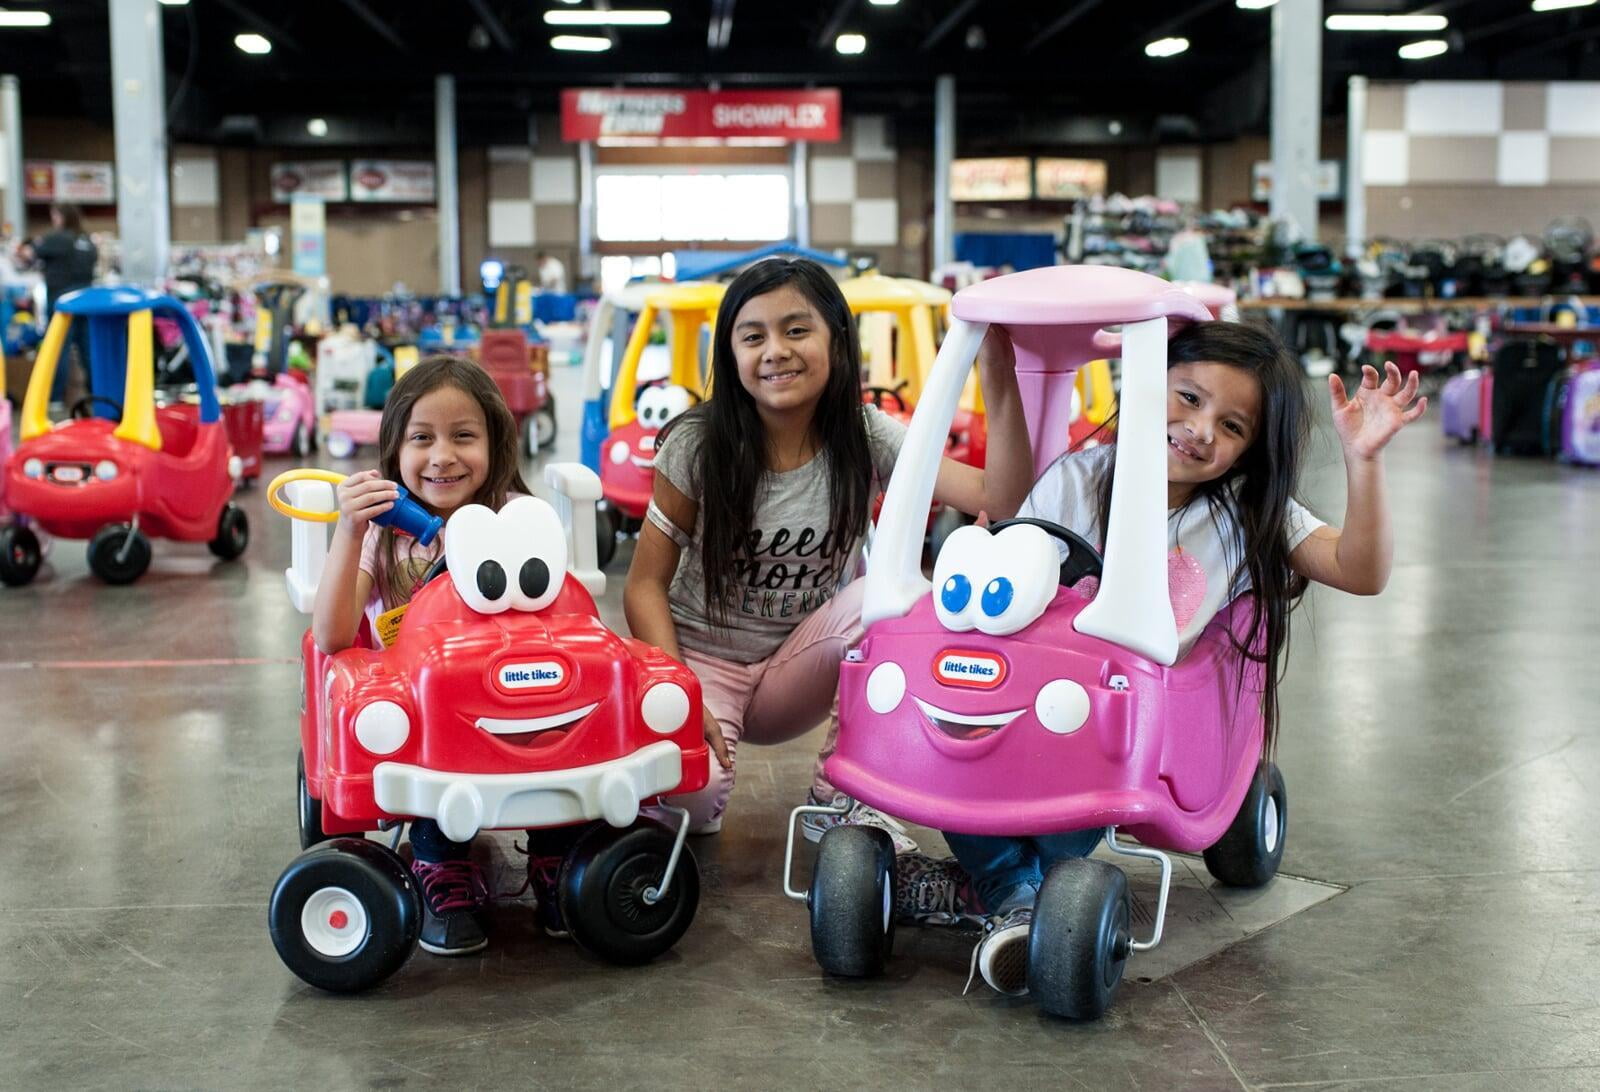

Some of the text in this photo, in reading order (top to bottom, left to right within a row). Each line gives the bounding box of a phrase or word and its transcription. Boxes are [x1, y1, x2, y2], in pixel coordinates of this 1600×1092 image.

[712, 103, 826, 128] SHOWPLEX
[944, 661, 994, 675] little tikes
[505, 669, 558, 682] little tikes
